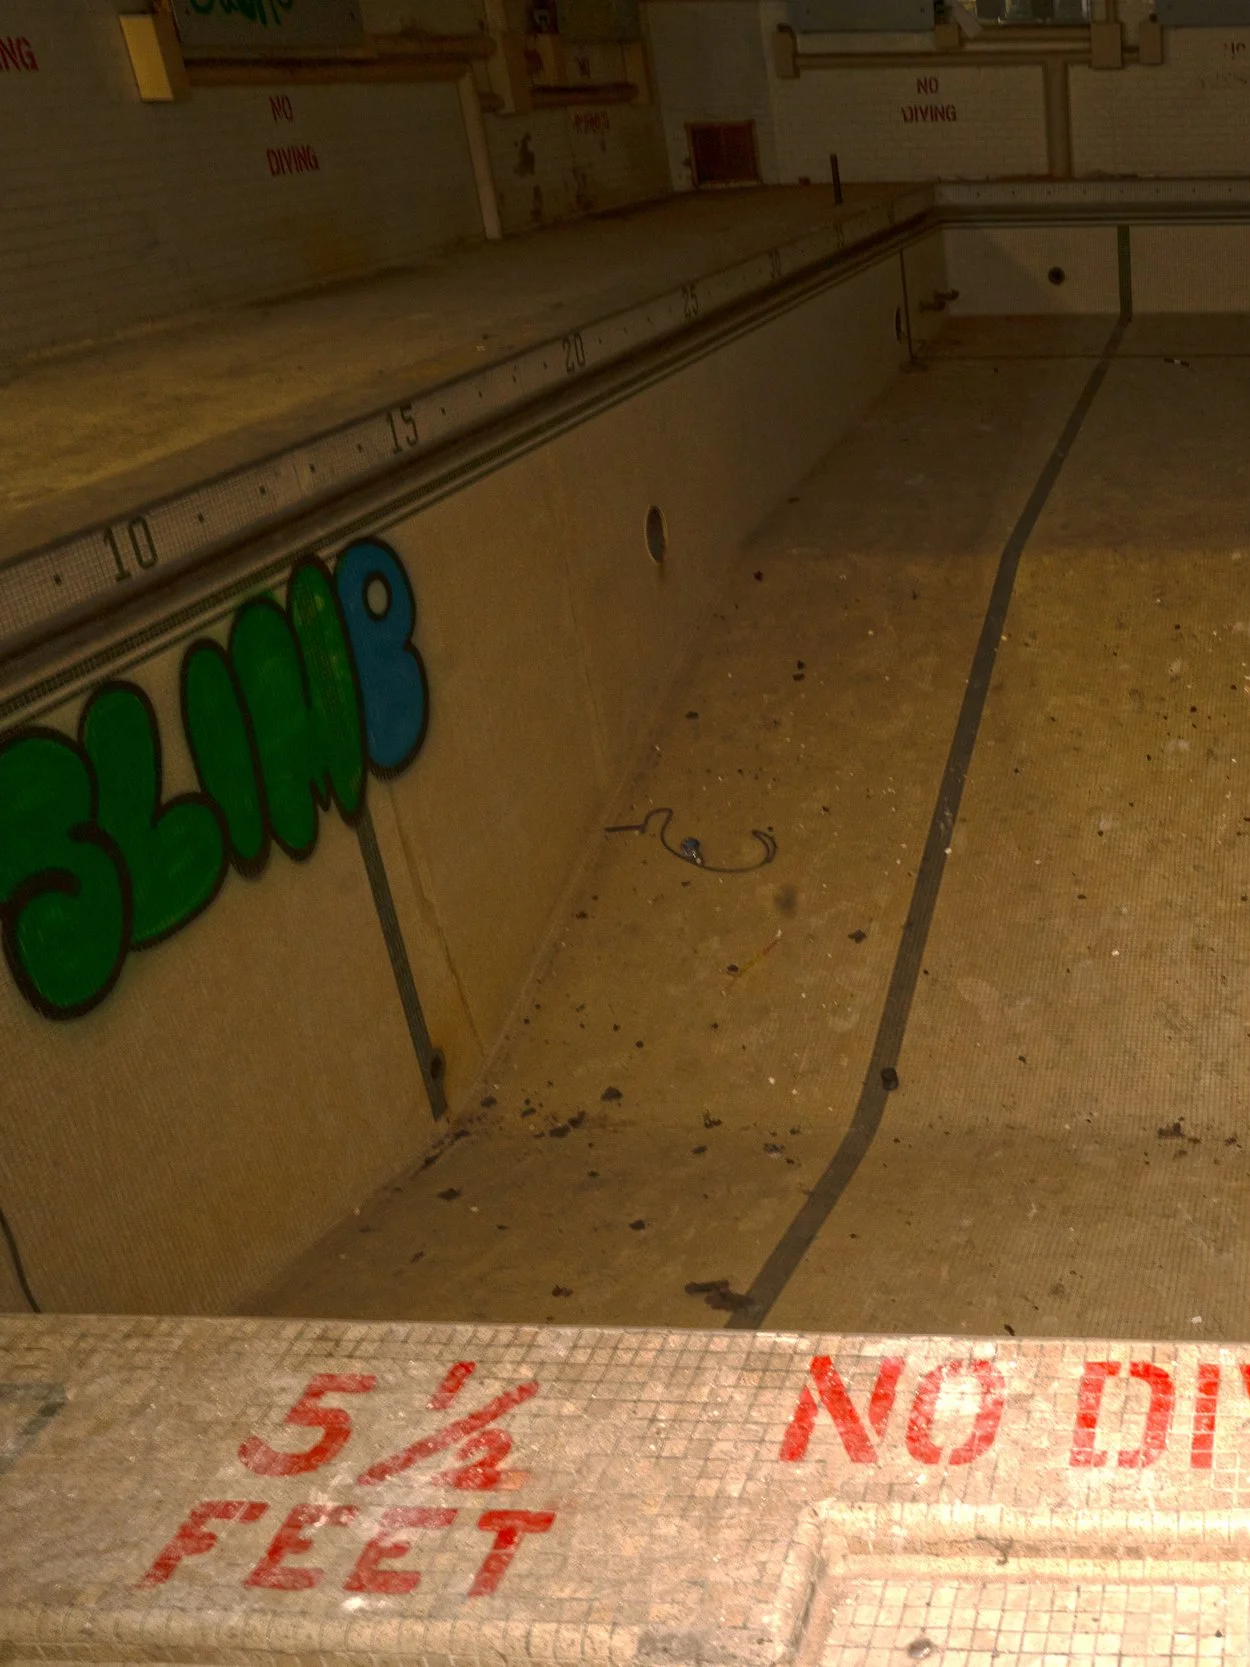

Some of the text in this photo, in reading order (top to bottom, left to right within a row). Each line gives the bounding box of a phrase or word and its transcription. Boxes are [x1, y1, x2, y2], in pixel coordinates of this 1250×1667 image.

[0, 35, 39, 72] NG
[916, 76, 940, 94] NO
[268, 95, 293, 122] NO
[901, 104, 957, 122] DIVING
[266, 145, 320, 176] DIVING
[682, 283, 699, 319] 25
[562, 332, 585, 372] 20
[386, 400, 418, 454] 15
[103, 516, 158, 582] 10
[778, 1354, 1006, 1466] NO
[138, 1501, 556, 1598] FEET
